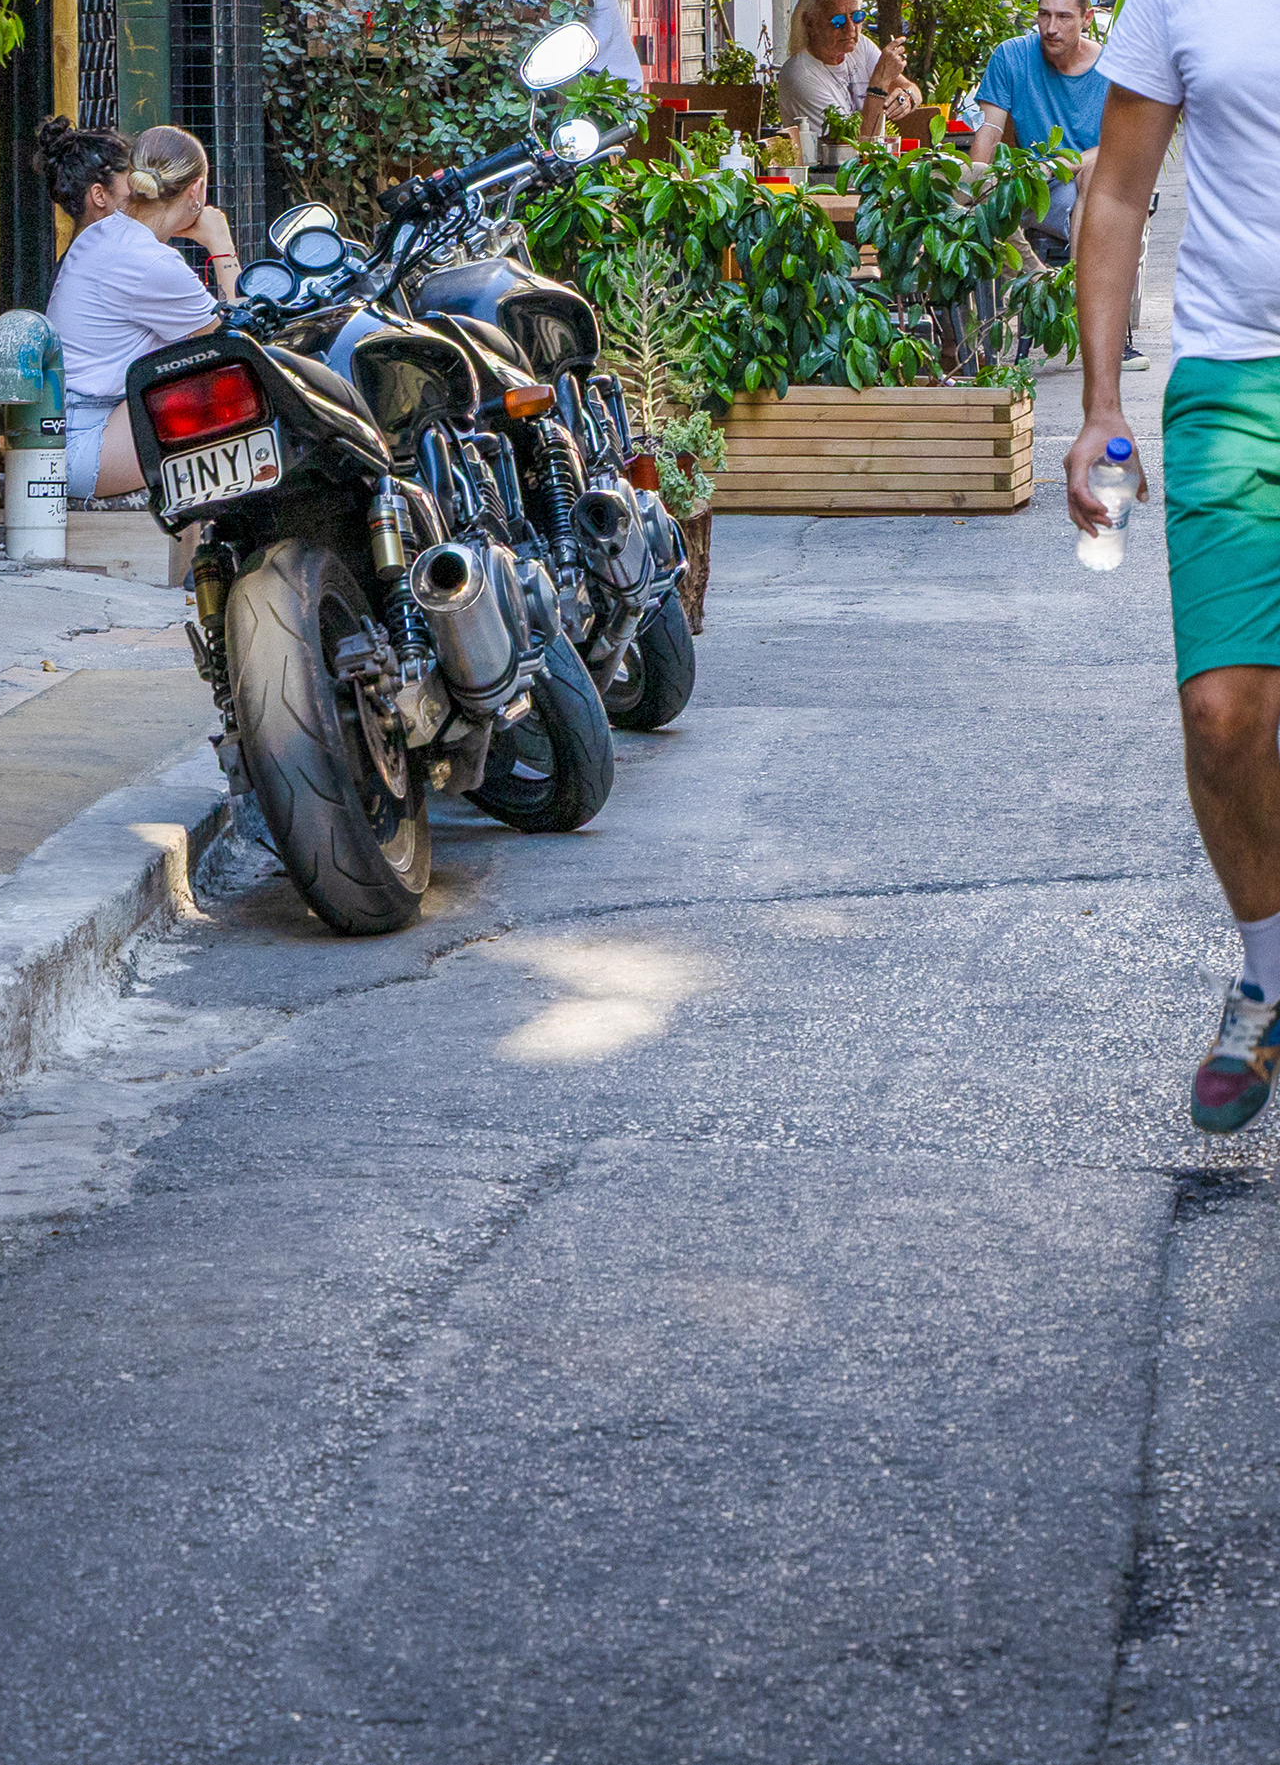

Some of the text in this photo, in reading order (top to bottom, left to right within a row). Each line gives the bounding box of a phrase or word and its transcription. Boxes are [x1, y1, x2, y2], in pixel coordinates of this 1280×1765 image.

[154, 349, 221, 374] HONDA
[172, 444, 240, 499] HNY
[29, 483, 62, 497] OPEN
